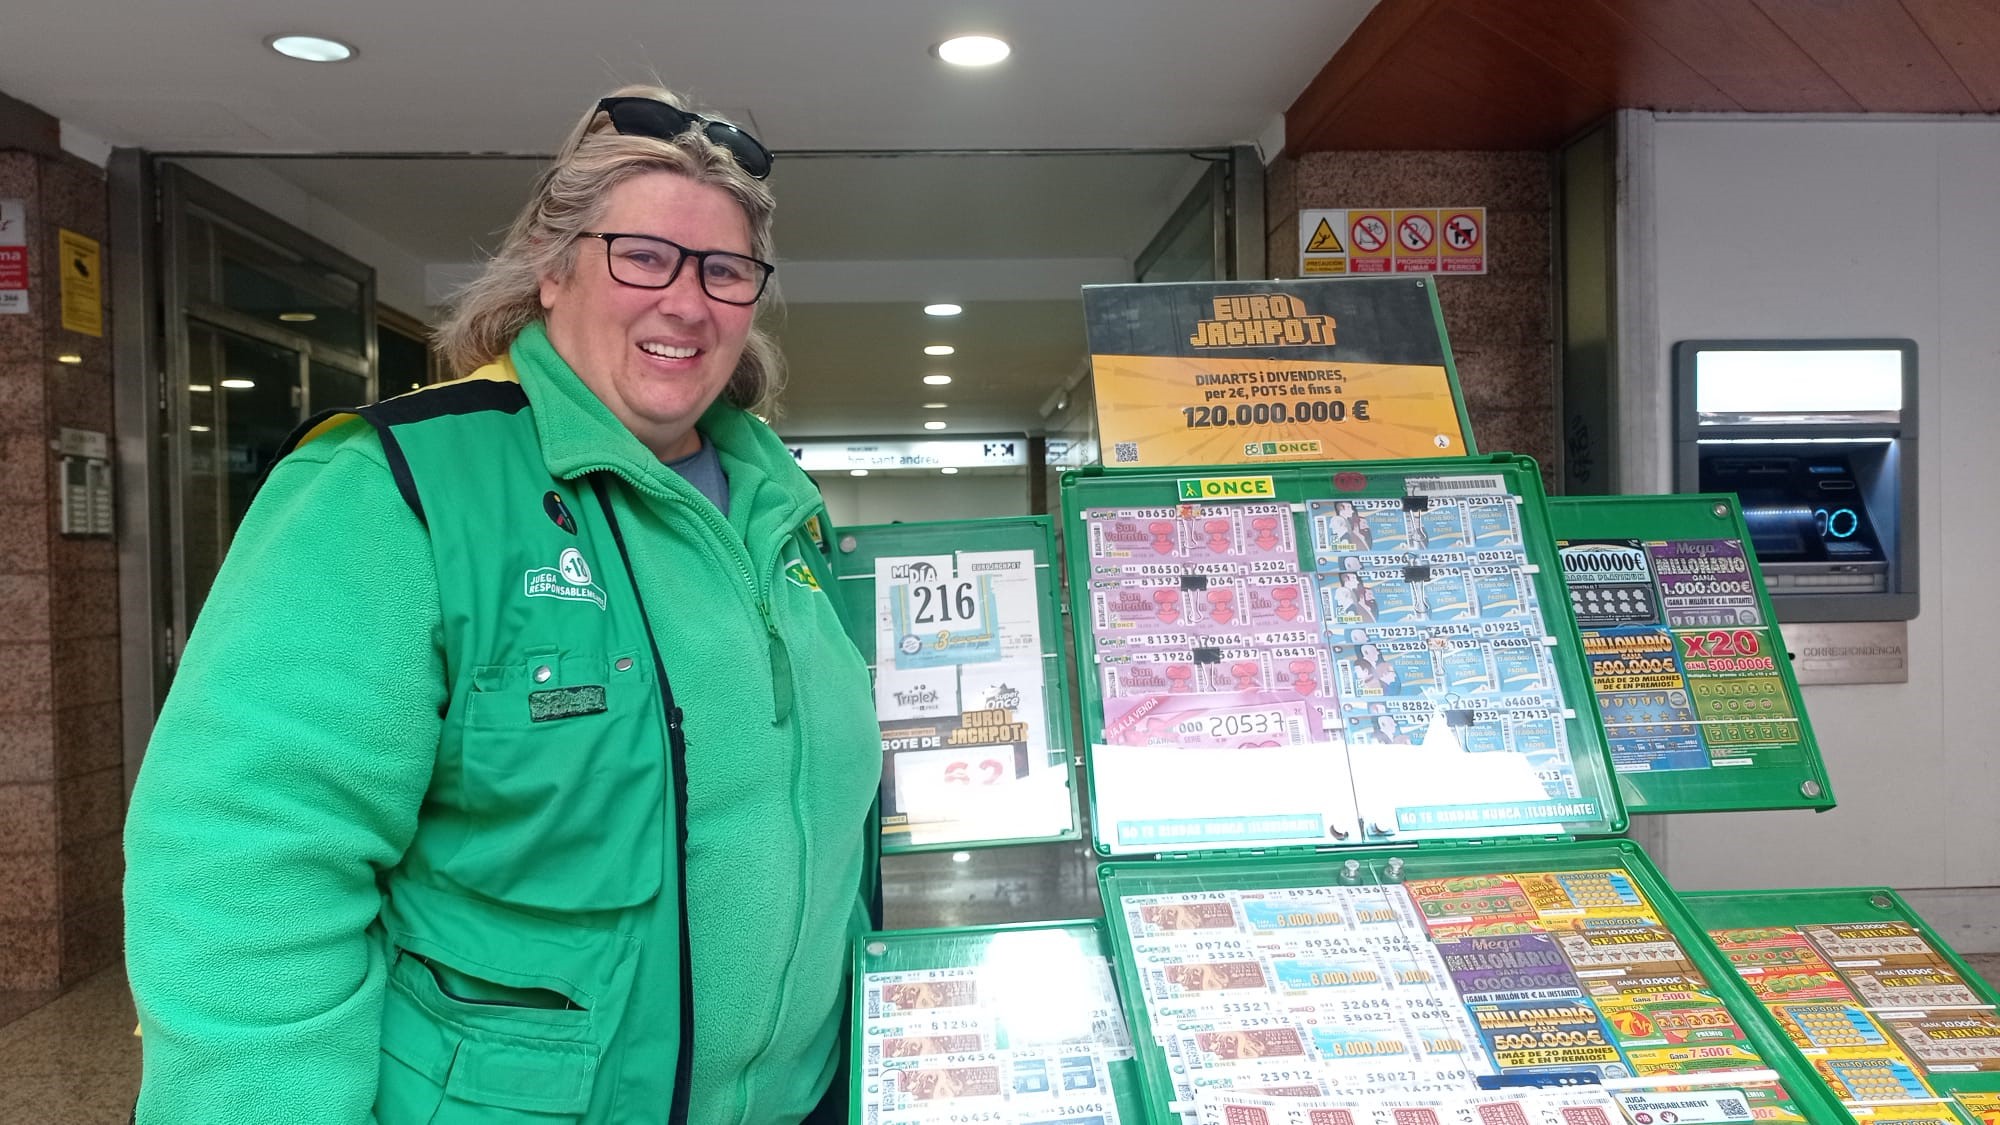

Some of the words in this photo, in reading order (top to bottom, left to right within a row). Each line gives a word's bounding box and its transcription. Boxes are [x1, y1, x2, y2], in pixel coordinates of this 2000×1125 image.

[1214, 294, 1291, 320] EURO
[1190, 318, 1324, 346] JACKPOT
[1195, 372, 1257, 386] DIMARTS
[1260, 371, 1264, 384] i
[1267, 369, 1347, 383] DIVENDRES,
[1205, 388, 1227, 401] per
[1228, 387, 1249, 400] 2€,
[1251, 385, 1288, 397] POTS
[1290, 384, 1305, 395] de
[1308, 382, 1331, 395] fins
[1334, 386, 1342, 394] a
[1183, 400, 1346, 428] 120.000.000
[1352, 400, 1370, 421] €
[1279, 442, 1319, 453] ONCE
[1206, 480, 1268, 495] ONCE
[1367, 501, 1400, 509] 57590
[1468, 497, 1503, 505] 02012
[1137, 509, 1176, 518] 08650
[1676, 542, 1715, 557] Mega
[1374, 557, 1408, 565] 57590
[1431, 553, 1464, 563] 42781
[1479, 551, 1513, 560] 02012
[564, 556, 588, 578] +18
[1142, 565, 1180, 575] 08650
[1198, 563, 1236, 574] 94541
[1474, 566, 1508, 575] 01925
[1655, 556, 1746, 575] MILLONARIO
[530, 573, 557, 586] JUEGA
[891, 564, 909, 579] MI
[908, 565, 938, 584] DÍA
[1141, 577, 1180, 586] 81393
[1258, 575, 1297, 585] 47435
[913, 583, 975, 624] 216
[1381, 627, 1416, 637] 70273
[1485, 622, 1520, 632] 01925
[934, 629, 951, 651] 3
[1147, 634, 1187, 645] 81393
[1202, 635, 1241, 646] 79064
[1266, 631, 1306, 643] 47435
[1391, 642, 1427, 651] 82826
[1493, 639, 1529, 647] 64608
[1583, 635, 1673, 655] MILLONARIO
[1681, 630, 1759, 658] x20
[1153, 652, 1193, 662] 31926
[1276, 647, 1315, 657] 68418
[1803, 646, 1902, 657] CORRESPONDENCIA
[1593, 658, 1676, 676] 500.000€
[1685, 661, 1707, 670] GANA
[1707, 657, 1774, 672] 500.000€
[1642, 674, 1681, 682] MILLONES
[1454, 699, 1489, 709] 21057
[1505, 696, 1541, 707] 64608
[1133, 698, 1159, 719] VENDA
[1512, 709, 1548, 719] 27413
[962, 709, 1005, 728] EURO
[1178, 721, 1203, 734] 000
[1210, 712, 1287, 738] 20537
[881, 738, 919, 750] BOTE
[922, 736, 941, 748] DE
[947, 722, 1023, 745] JACKPOT
[1401, 813, 1417, 825] NO
[1421, 812, 1432, 824] TE
[1482, 808, 1521, 820] NUNCA
[1525, 803, 1596, 818] ¡ILUSIÓNATE!
[1182, 892, 1226, 901] 09740
[1277, 911, 1340, 928] 6.000.000
[1606, 927, 1646, 936] 10.000€
[1839, 931, 1860, 940] SE
[1863, 928, 1910, 938] BUSCA
[1305, 937, 1351, 948] 89341
[1590, 937, 1609, 946] SE
[1613, 933, 1665, 945] BUSCA
[1195, 940, 1241, 951] 09740
[1471, 938, 1521, 953] Mega
[1208, 950, 1254, 960] 53521
[1446, 950, 1563, 972] MILLONARIO
[1895, 968, 1935, 976] 10.000€
[1311, 970, 1378, 986] 6.000.000
[1457, 970, 1574, 992] 1.000.000€
[1639, 976, 1682, 986] 10.000€
[1882, 978, 1904, 987] SE
[1466, 995, 1488, 1003] ¡GANA
[1495, 993, 1519, 1002] MILLÓN
[1538, 991, 1547, 999] AL
[1547, 989, 1580, 998] INSTANTE!
[1651, 991, 1694, 1001] 7.500€
[1223, 1001, 1271, 1013] 53521
[1341, 998, 1391, 1010] 32684
[1240, 1016, 1290, 1027] 23912
[1344, 1012, 1393, 1022] 58027
[1476, 1006, 1597, 1029] MILLONARIO
[1494, 1030, 1606, 1050] 500.000€
[1695, 1031, 1723, 1039] PREMIO
[1929, 1030, 1949, 1040] SE
[1333, 1039, 1404, 1057] 6.000.000
[1498, 1051, 1526, 1060] ¡MÁS
[1562, 1047, 1614, 1056] MILLONES
[1689, 1048, 1733, 1059] 7.500€
[1554, 1054, 1607, 1064] PREMIOS!
[1261, 1069, 1313, 1083] 23912
[1367, 1070, 1417, 1084] 58027
[1624, 1096, 1646, 1104] JUGA
[1058, 1103, 1103, 1116] 36048
[1628, 1100, 1710, 1112] RESPONSABLEMENT
